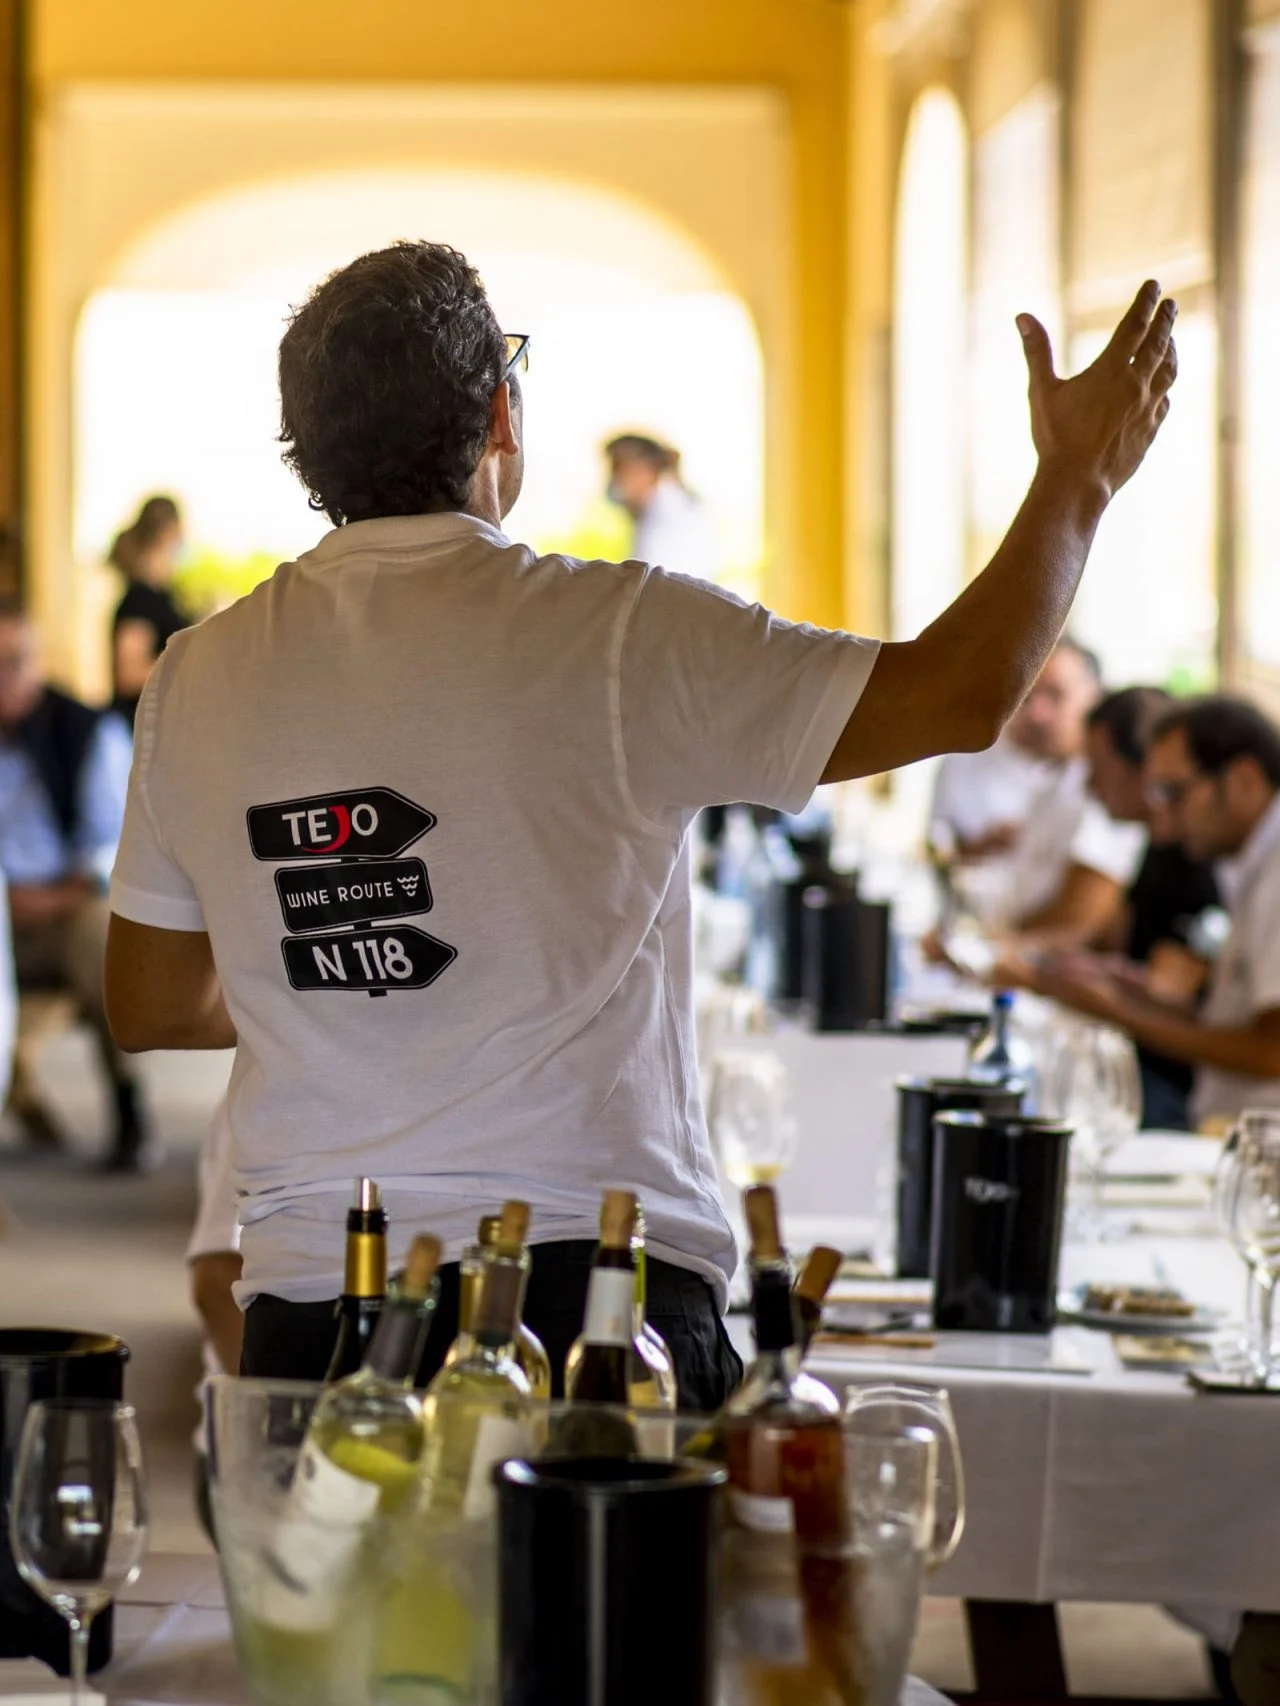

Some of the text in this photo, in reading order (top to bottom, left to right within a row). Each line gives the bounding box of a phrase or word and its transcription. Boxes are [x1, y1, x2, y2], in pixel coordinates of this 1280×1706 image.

[282, 803, 379, 854] TEJO
[286, 881, 394, 908] WINE ROUTE
[312, 937, 414, 981] N 118
